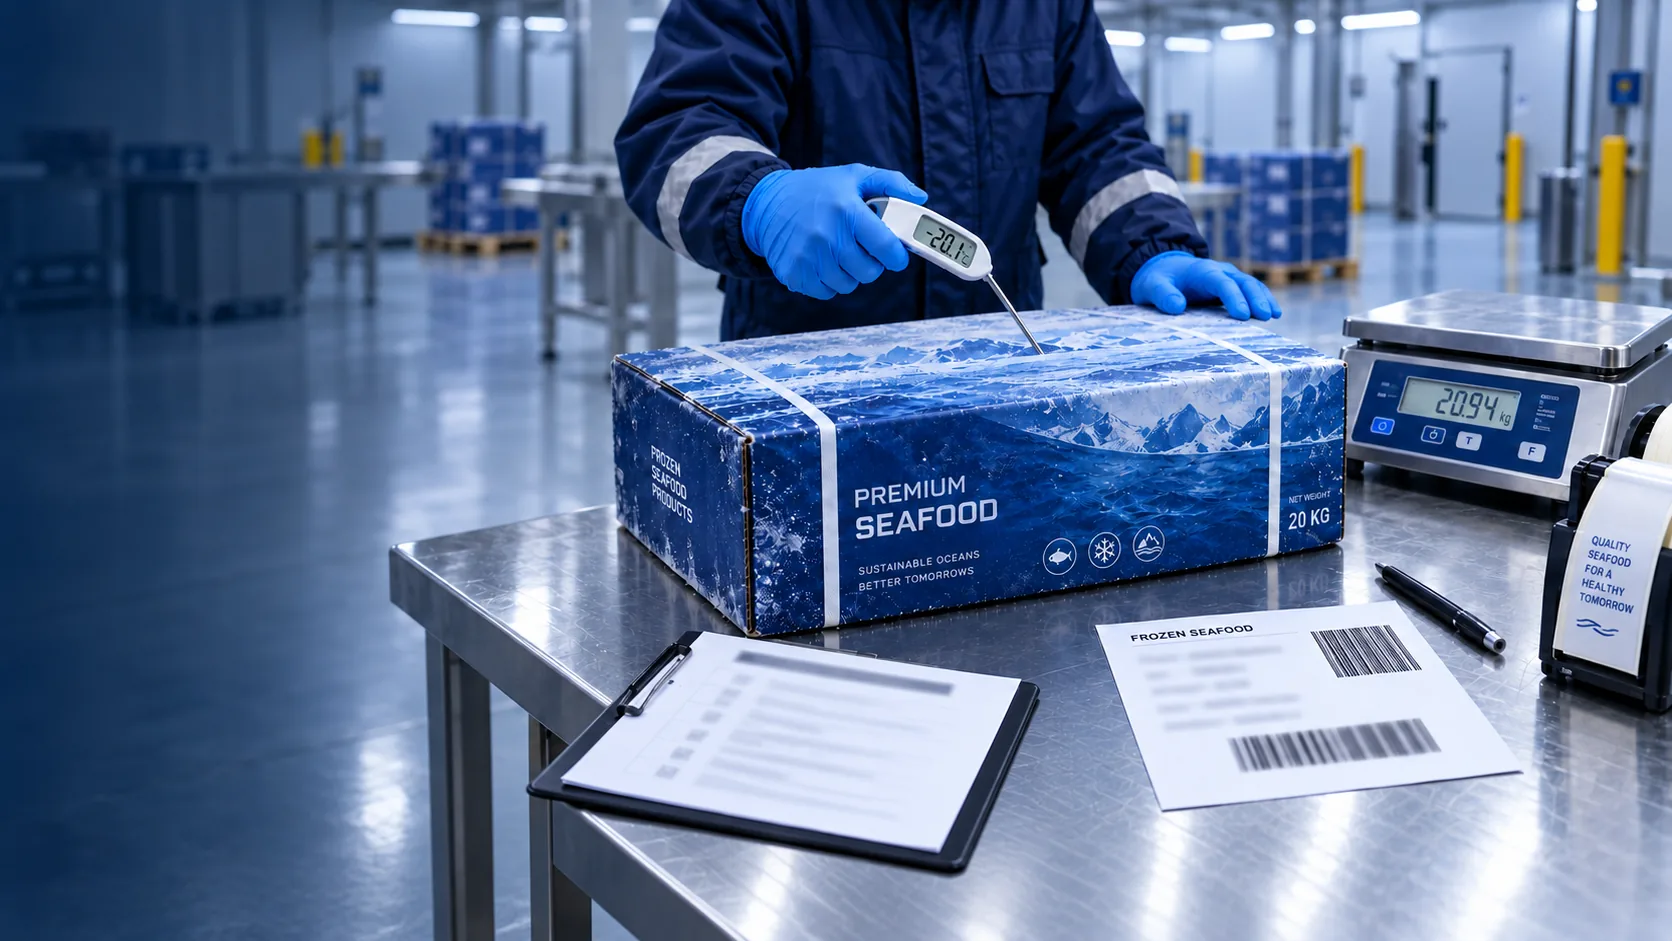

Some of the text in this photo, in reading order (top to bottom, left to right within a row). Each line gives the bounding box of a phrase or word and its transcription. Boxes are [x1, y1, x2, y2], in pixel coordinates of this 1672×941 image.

[1435, 388, 1499, 421] 20.94
[1499, 412, 1511, 426] kg
[1466, 436, 1473, 445] T
[1528, 447, 1536, 456] F
[651, 445, 681, 478] FROZEN
[651, 465, 687, 500] SEAFOOD
[854, 475, 965, 508] PREMIUM
[652, 483, 693, 523] PRODUCTS
[1288, 495, 1303, 504] NET
[855, 498, 998, 539] SEAFOOD
[1288, 507, 1330, 530] 20 KG
[1591, 535, 1631, 553] QUALITY
[858, 550, 980, 576] SUSTAINABLE OCEANS
[1587, 549, 1632, 568] SEAFOOD
[858, 566, 975, 591] BETTER TOMORROWS
[1584, 564, 1612, 579] FOR A
[1581, 578, 1625, 597] HEALTHY
[1579, 592, 1634, 614] TOMORROW
[1130, 624, 1254, 642] FROZEN SEAFOOD
